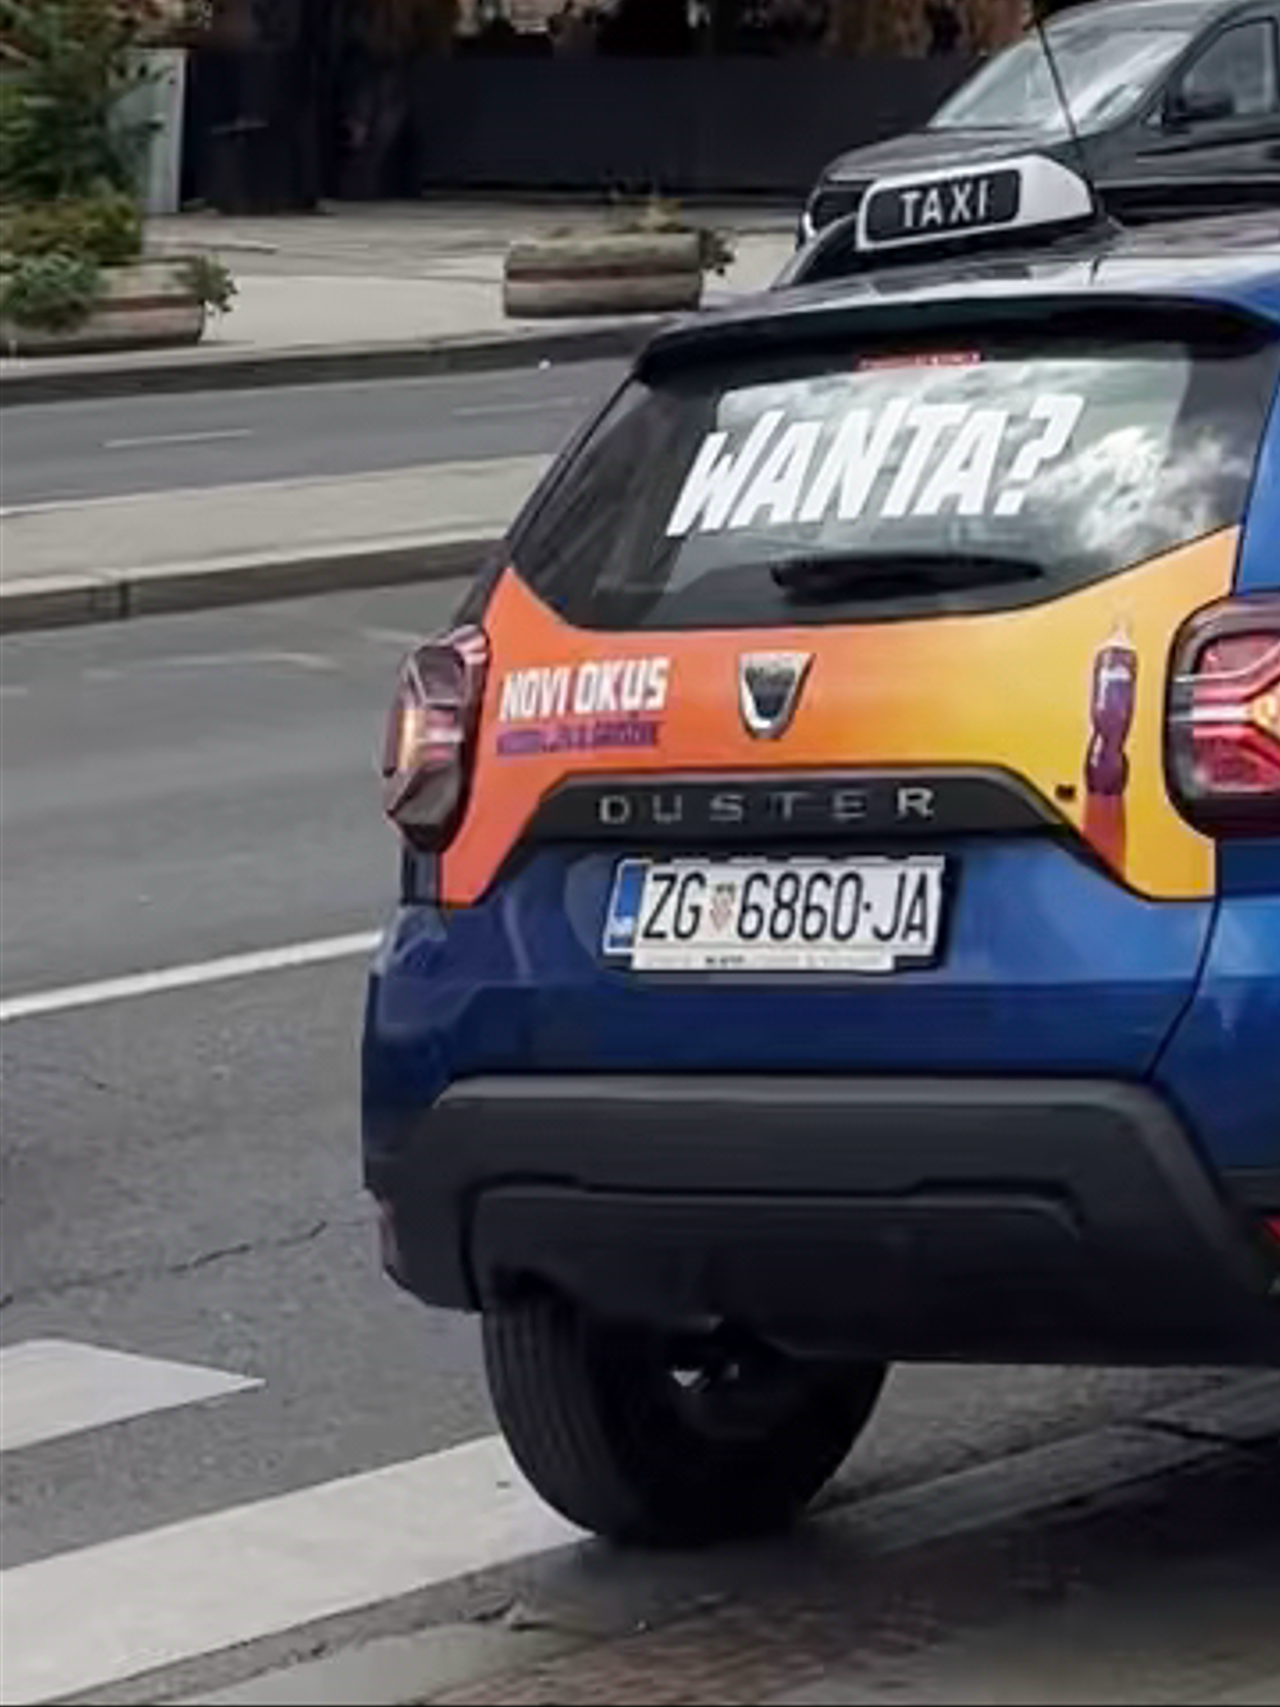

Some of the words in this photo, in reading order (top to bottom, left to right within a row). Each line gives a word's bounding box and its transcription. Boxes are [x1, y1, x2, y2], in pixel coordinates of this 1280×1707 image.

[900, 179, 988, 228] TAXI
[666, 395, 1085, 536] WANTA?
[500, 666, 571, 721] NOVI
[574, 656, 669, 715] OKUS
[600, 786, 935, 825] DUSTER
[643, 871, 707, 939] ZG
